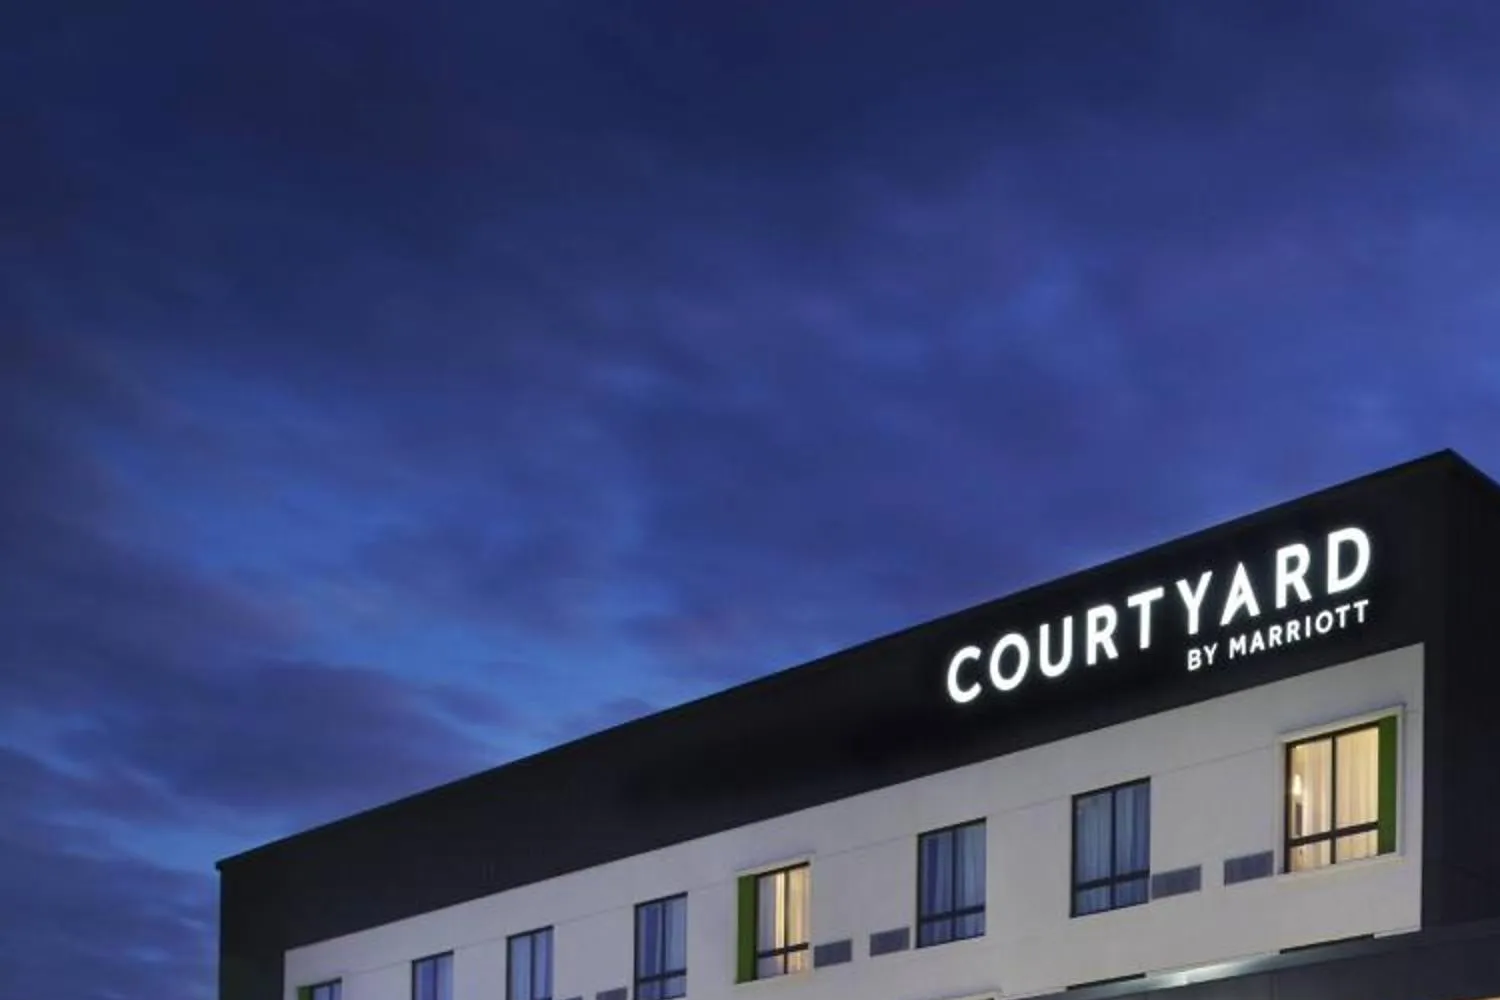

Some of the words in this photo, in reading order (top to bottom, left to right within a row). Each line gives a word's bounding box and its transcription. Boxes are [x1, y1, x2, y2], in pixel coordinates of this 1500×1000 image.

[947, 527, 1371, 704] COURTYARD
[1187, 643, 1218, 671] BY
[1229, 599, 1369, 660] MARRIOTT
